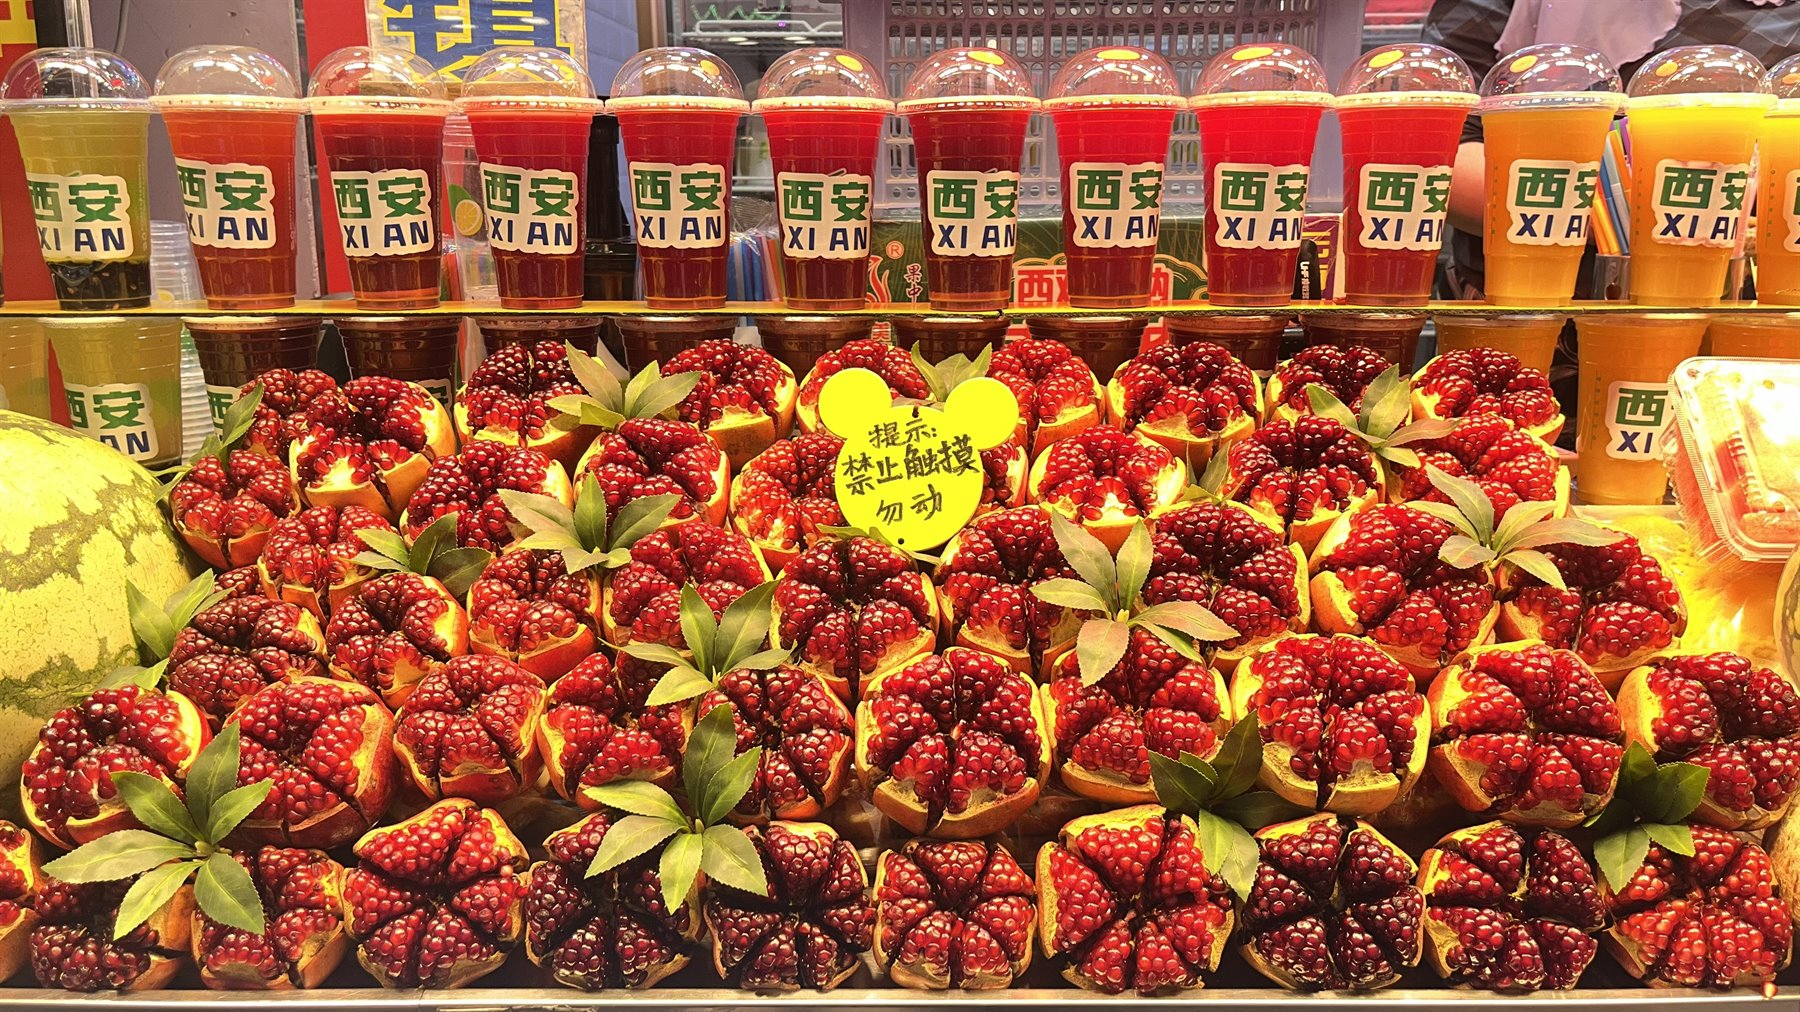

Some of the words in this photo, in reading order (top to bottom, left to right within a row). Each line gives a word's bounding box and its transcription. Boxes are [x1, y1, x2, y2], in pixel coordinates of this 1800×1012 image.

[28, 181, 121, 222] 西安
[177, 168, 268, 211] 西安
[334, 177, 426, 218] 西安
[484, 170, 574, 217] 西安
[633, 169, 722, 211] 西安
[783, 179, 869, 221] 西安
[933, 178, 1018, 219] 西安
[1077, 170, 1162, 210] 西安
[1221, 170, 1308, 211] 西安
[1367, 170, 1453, 212] 西安
[1660, 166, 1749, 210] 西安
[75, 228, 125, 252] AN
[217, 217, 268, 241] AN
[343, 225, 370, 249] XI
[384, 220, 430, 248] AN
[491, 216, 514, 242] XI
[527, 222, 573, 246] AN
[640, 215, 665, 240] XI
[680, 216, 721, 240] AN
[788, 226, 815, 250] XI
[829, 227, 868, 251] AN
[937, 224, 968, 249] XI
[981, 224, 1016, 249] AN
[1080, 215, 1112, 240] XI
[1125, 214, 1160, 239] AN
[1223, 216, 1256, 241] XI
[1368, 217, 1404, 241] XI
[1516, 213, 1554, 238] XI
[1660, 212, 1700, 238] XI
[1617, 430, 1653, 454] XI
[841, 433, 980, 496] 禁止触摸
[876, 483, 943, 526] 勿动
